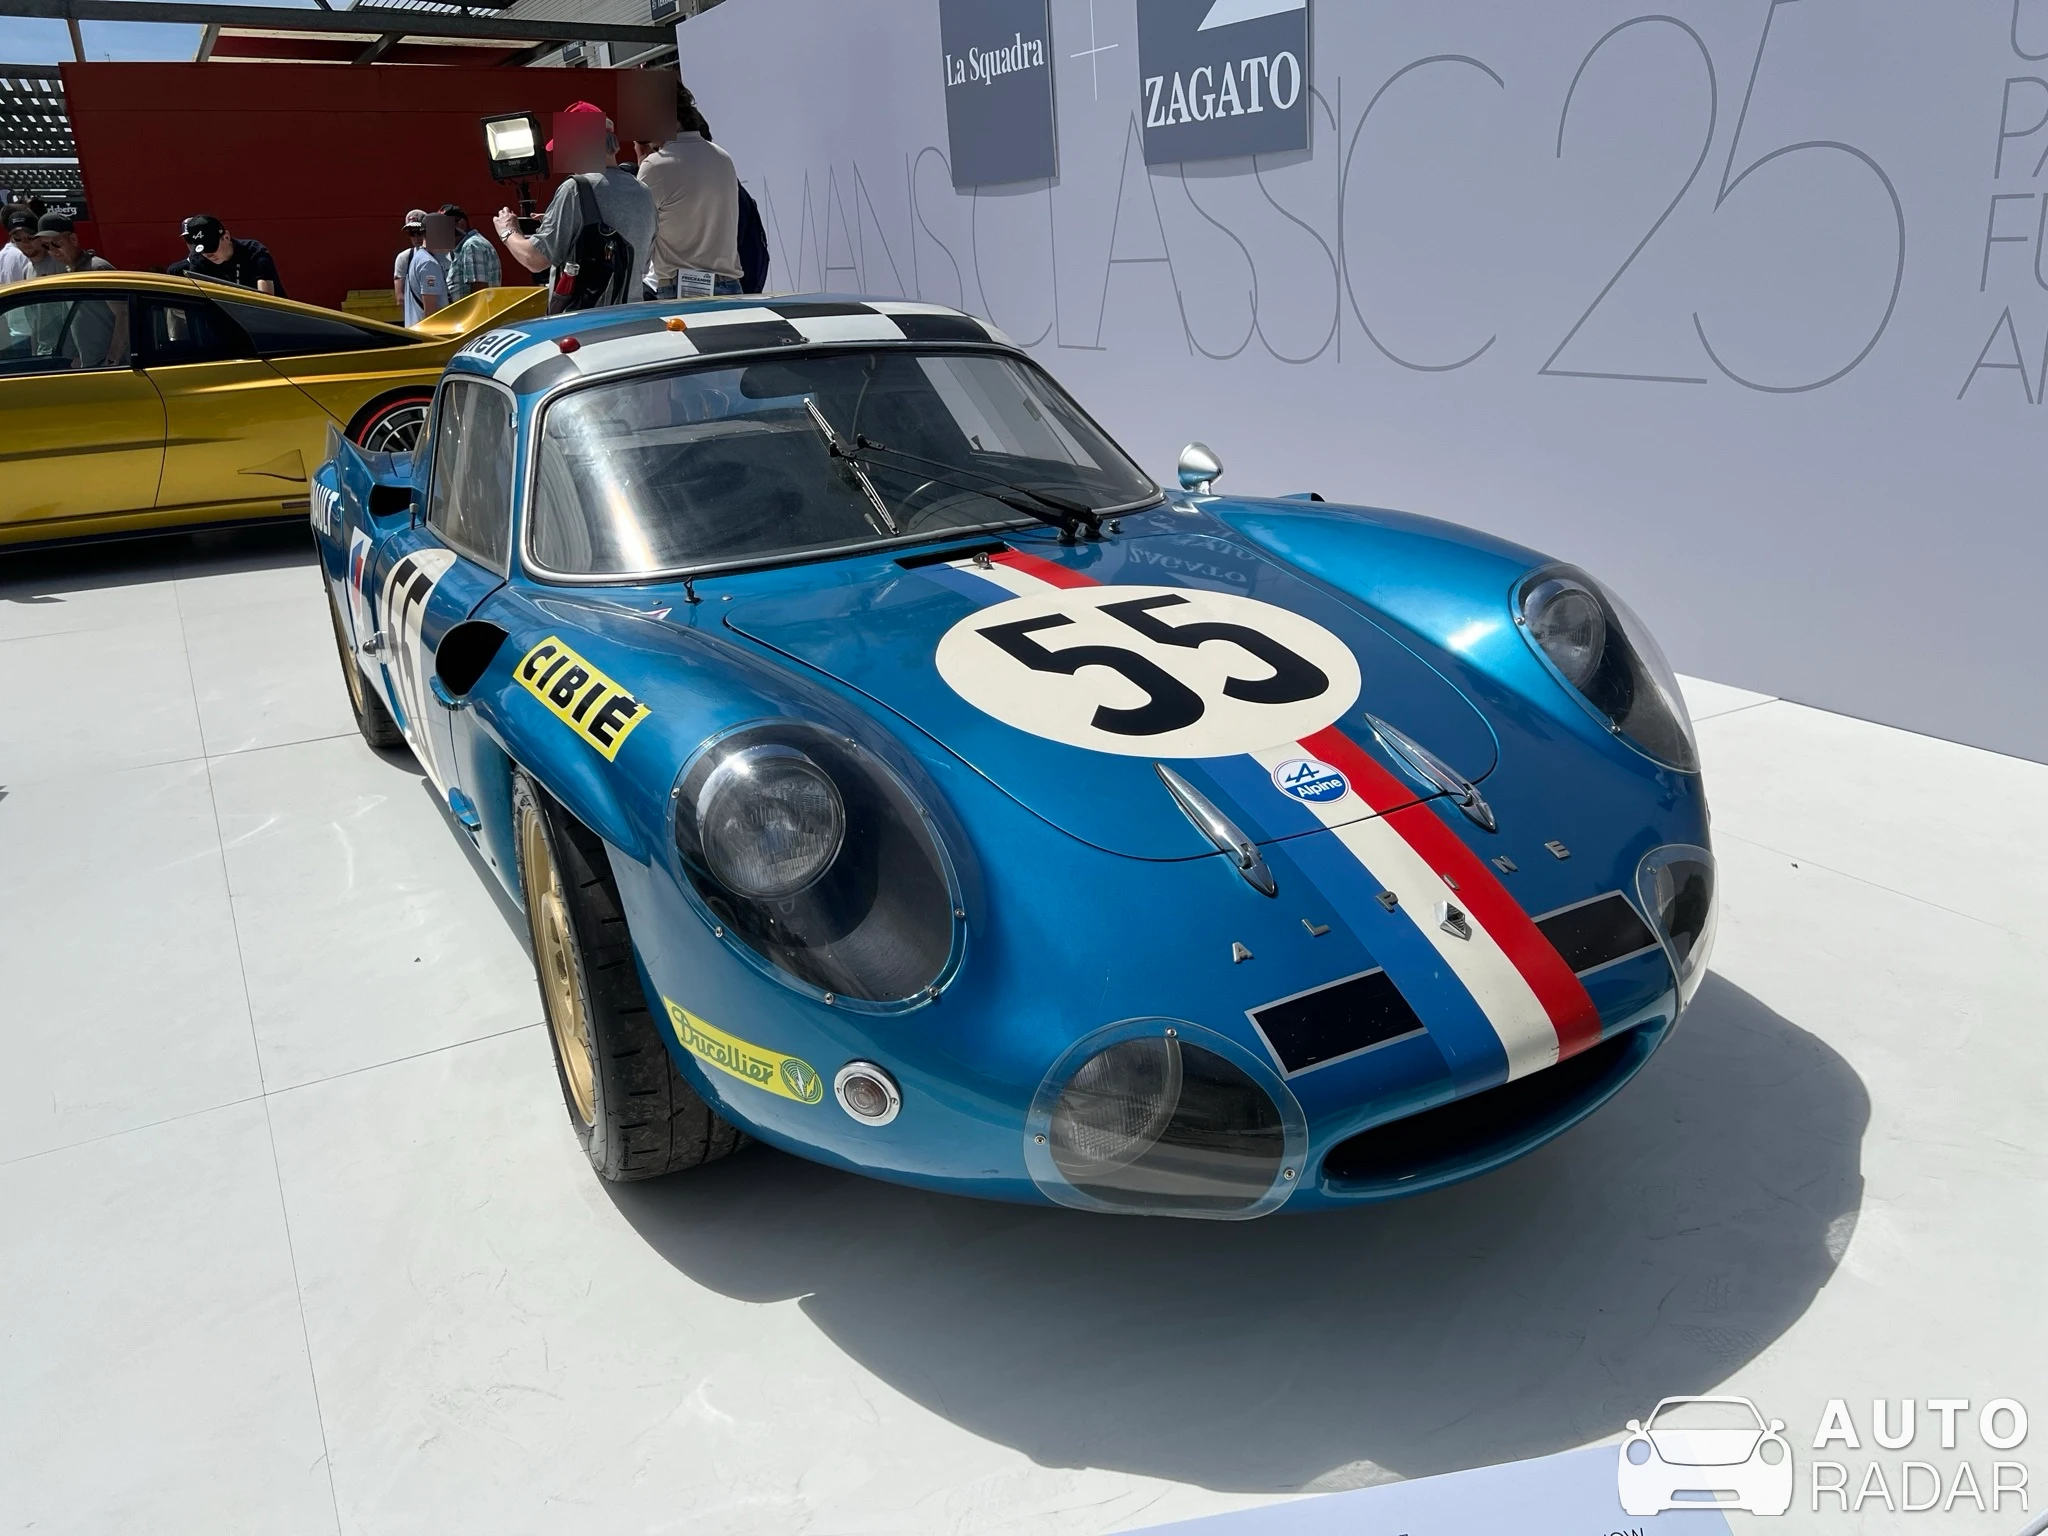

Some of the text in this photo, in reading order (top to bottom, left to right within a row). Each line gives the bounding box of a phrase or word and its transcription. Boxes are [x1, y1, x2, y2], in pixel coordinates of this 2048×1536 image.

[945, 32, 1045, 86] La Squadra
[1145, 51, 1301, 128] ZAGATO
[47, 203, 77, 216] rlsberg
[1537, 0, 1906, 394] 25
[458, 332, 524, 358] hell
[974, 593, 1330, 737] 55
[1296, 779, 1343, 798] Alpine
[671, 1006, 774, 1085] Ducellier
